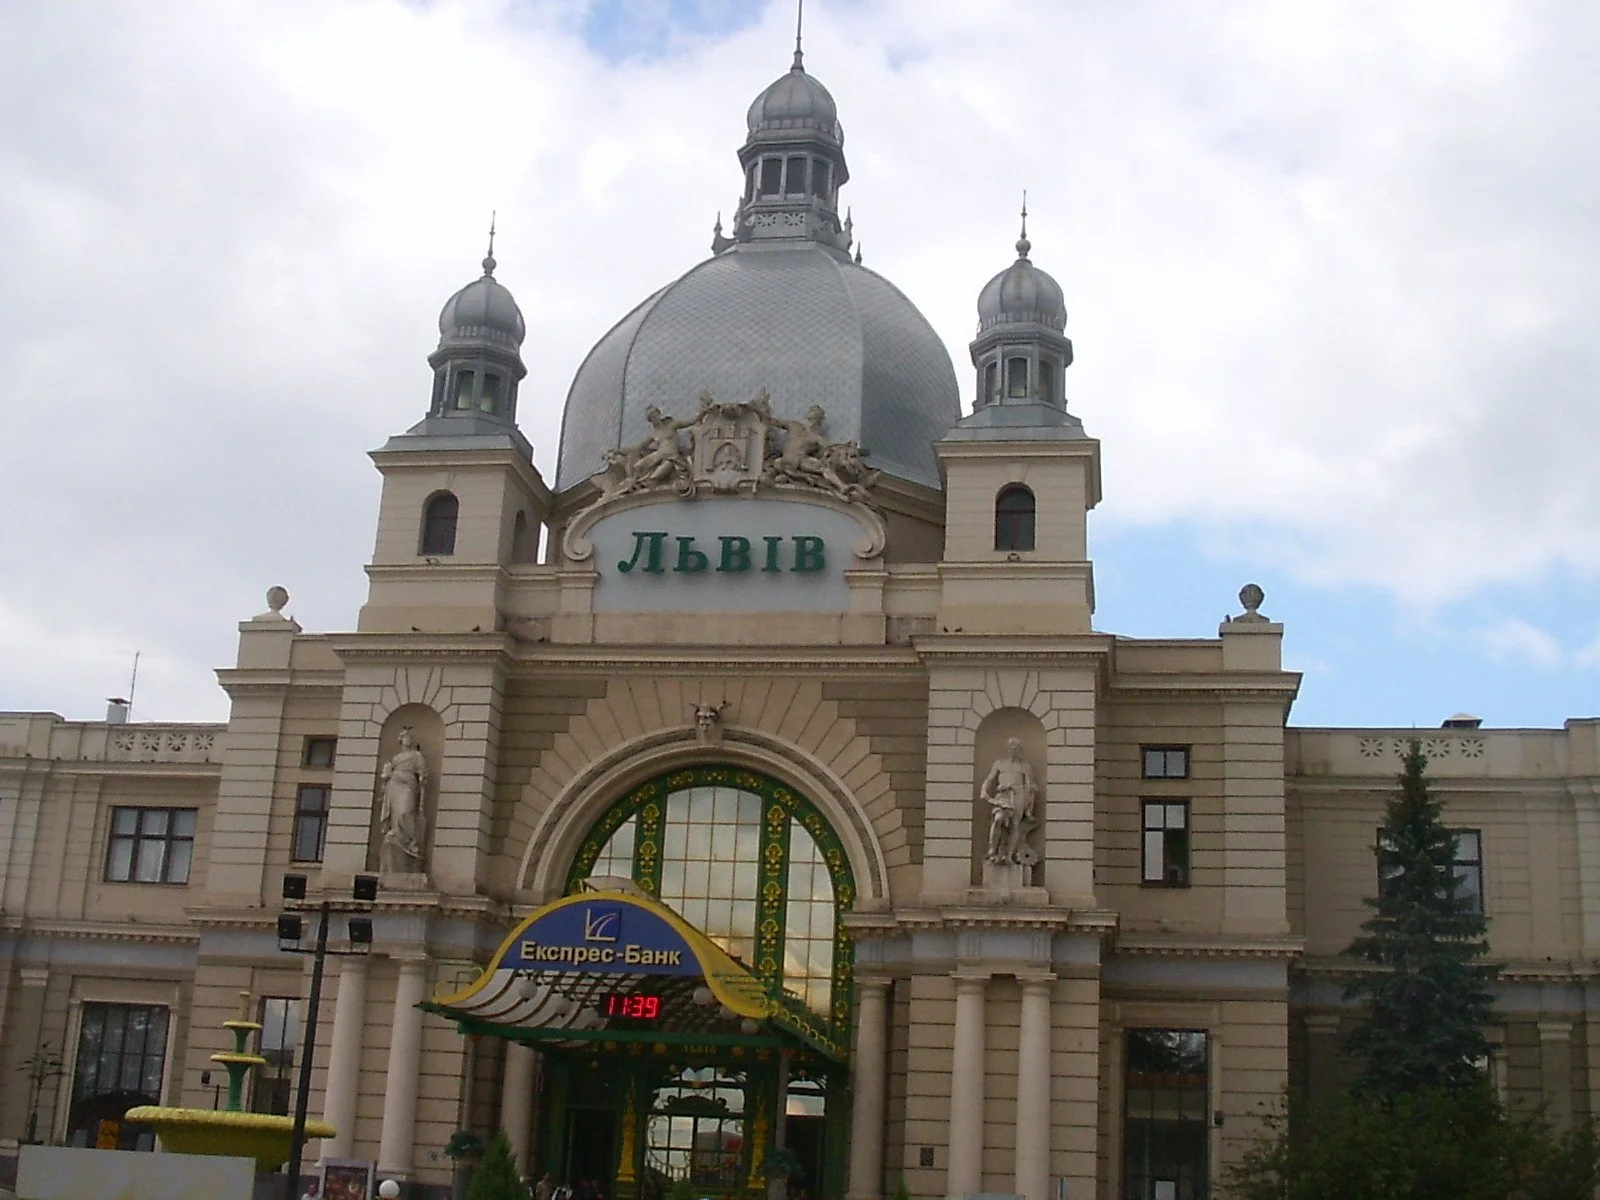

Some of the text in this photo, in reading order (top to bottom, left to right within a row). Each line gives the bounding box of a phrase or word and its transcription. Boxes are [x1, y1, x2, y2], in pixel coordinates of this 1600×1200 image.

[617, 531, 826, 573] ЛЬВІВ
[520, 940, 682, 966] Експрес-Банк
[608, 996, 659, 1018] 11:39
